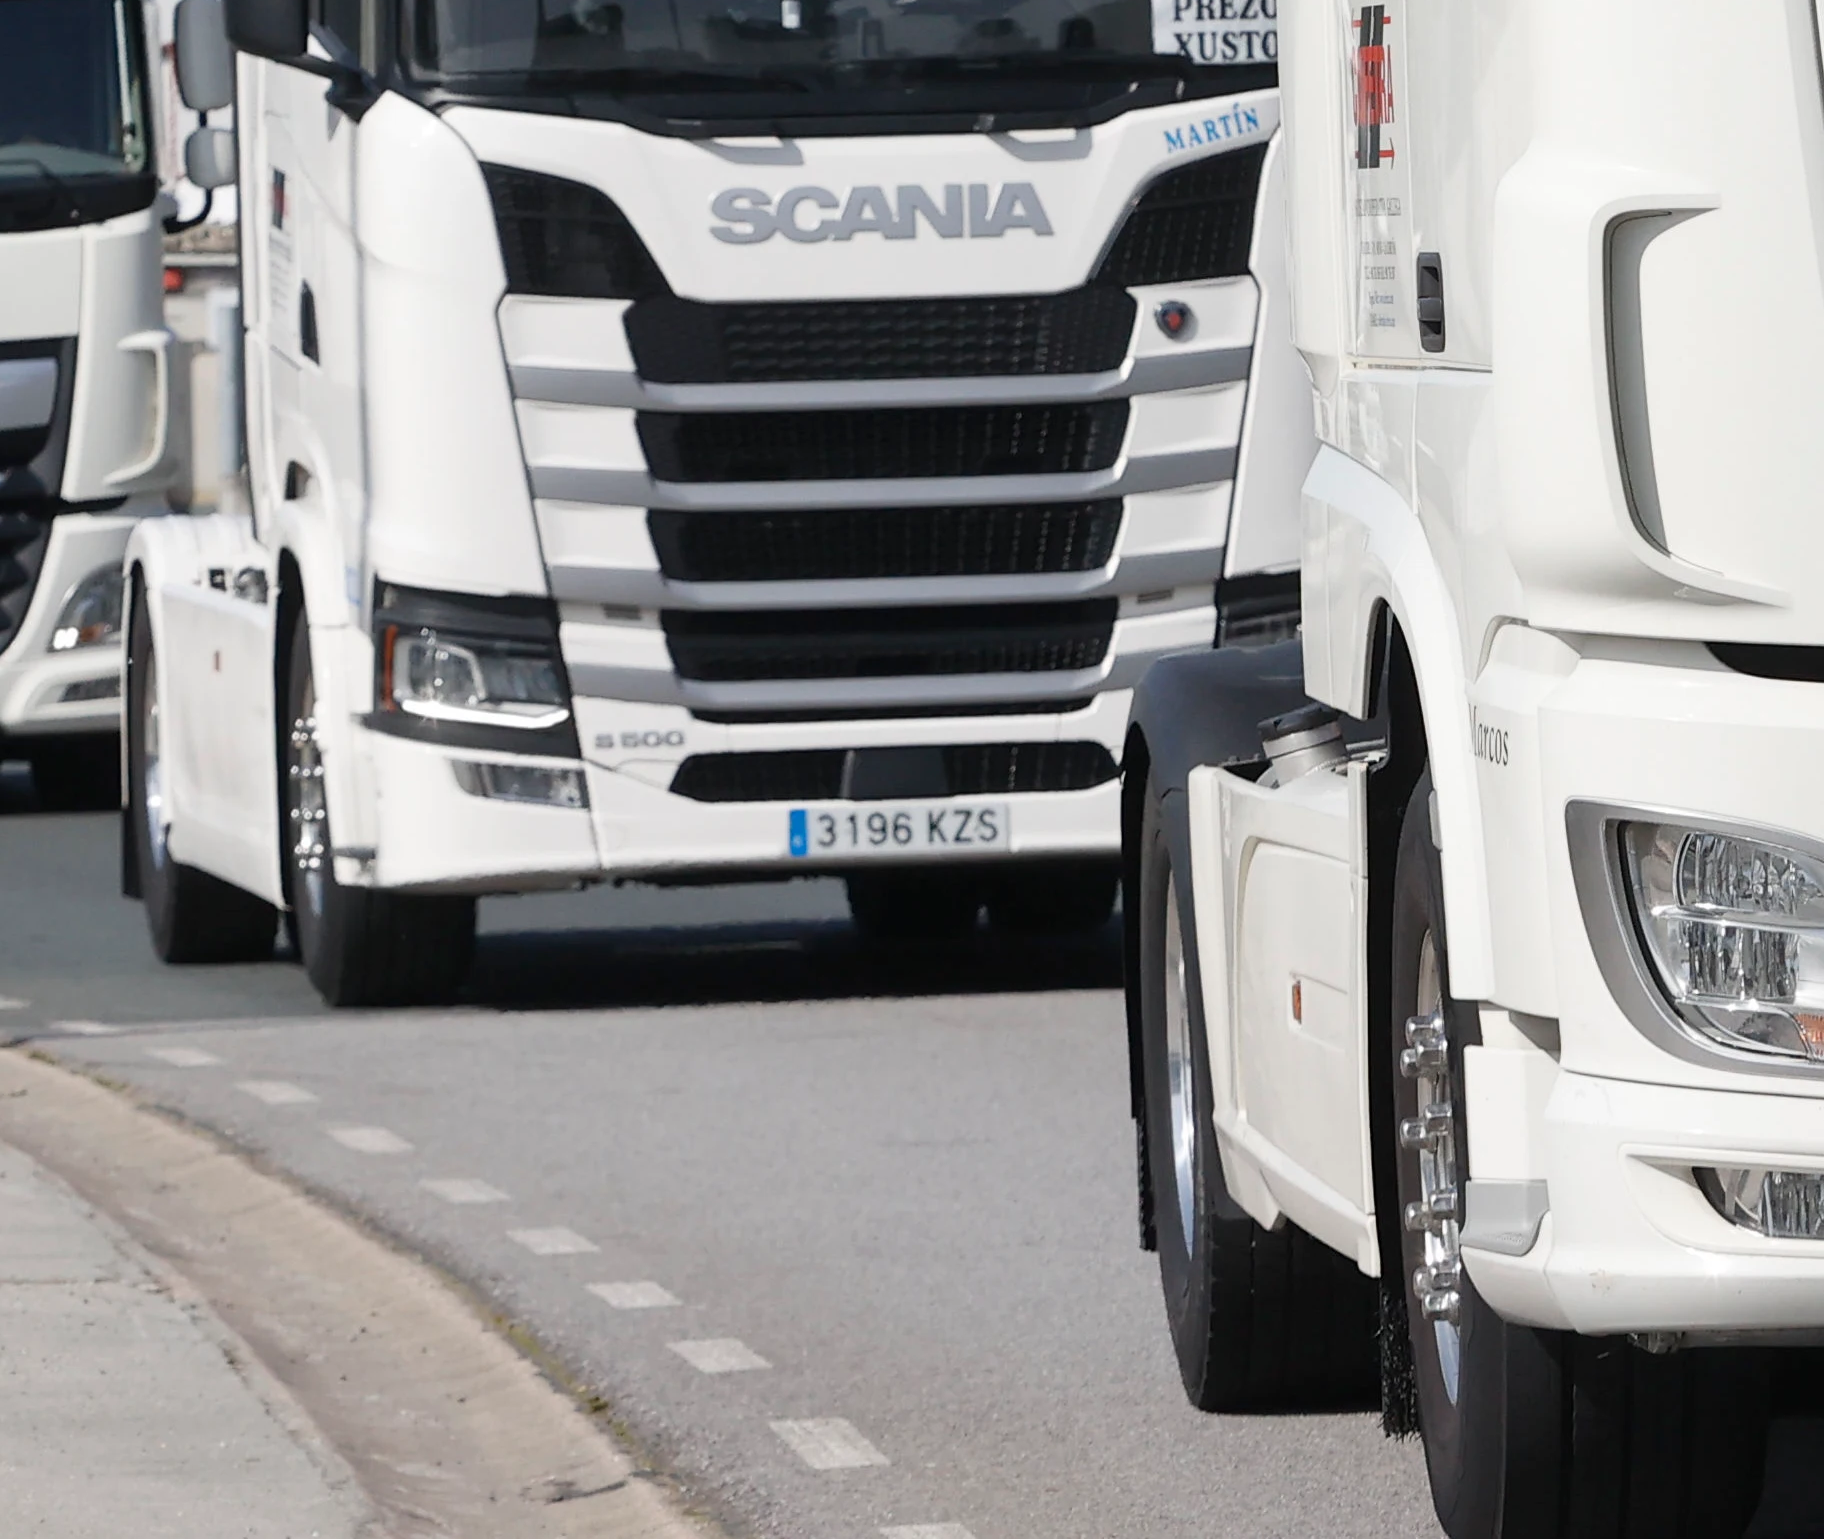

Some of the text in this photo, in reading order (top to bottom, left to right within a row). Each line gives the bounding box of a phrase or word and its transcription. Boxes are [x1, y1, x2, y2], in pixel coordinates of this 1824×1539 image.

[1164, 102, 1259, 153] MARTÍN
[709, 182, 1055, 244] SCANIA
[818, 809, 998, 847] 3196 KZS
